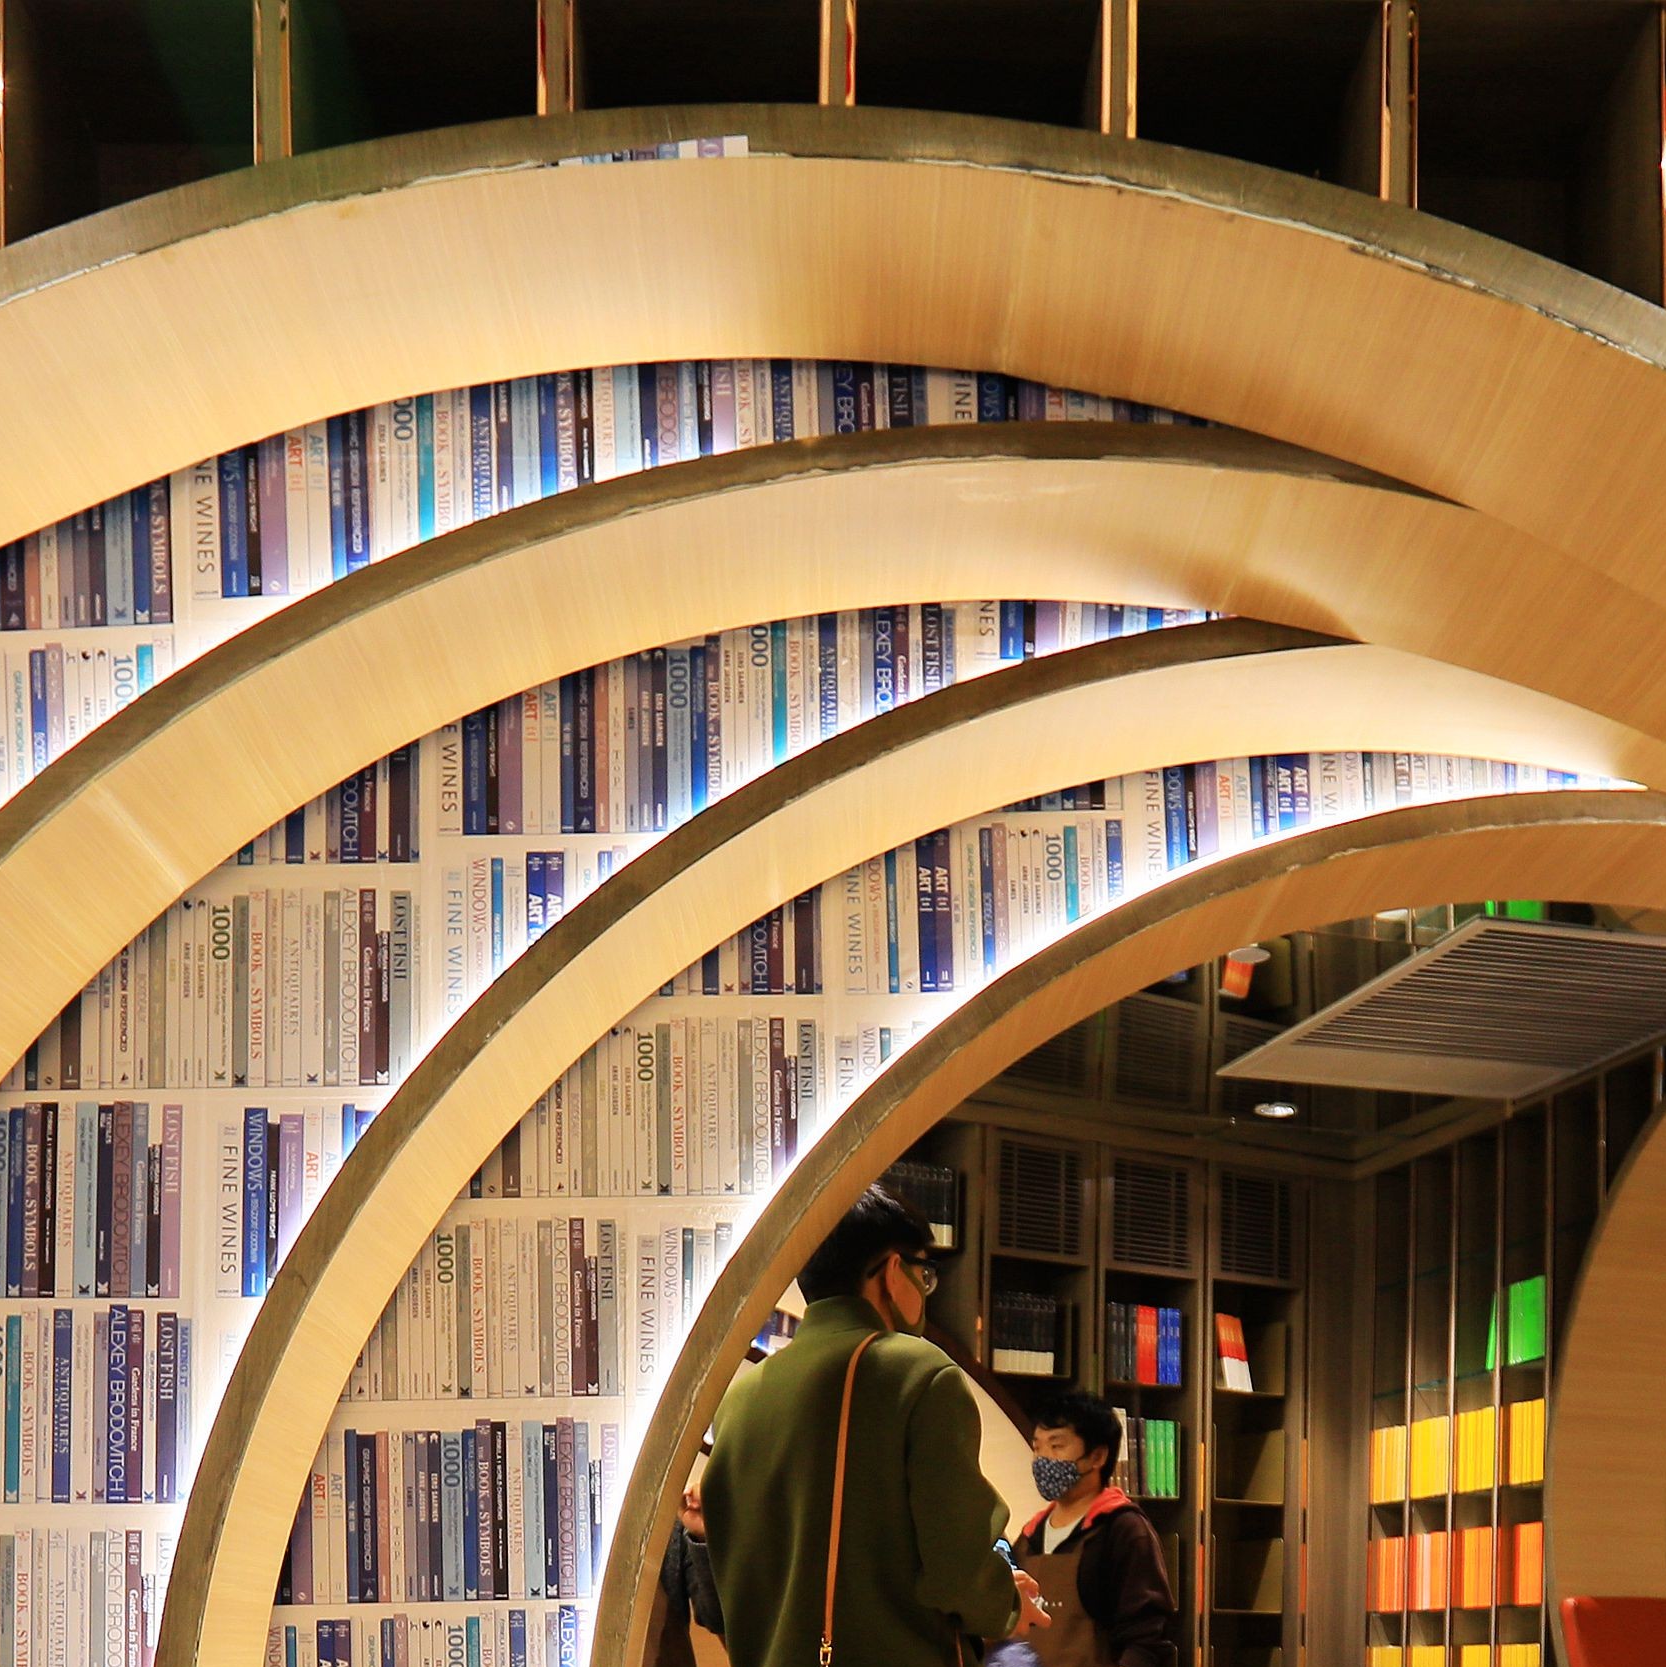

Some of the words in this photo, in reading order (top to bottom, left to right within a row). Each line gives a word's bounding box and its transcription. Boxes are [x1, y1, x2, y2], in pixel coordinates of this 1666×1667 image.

[196, 496, 214, 573] WINES
[667, 656, 688, 709] 1000
[442, 743, 457, 812] WINES
[919, 867, 931, 893] ART
[1046, 834, 1062, 881] 1000
[212, 906, 230, 960] 1000
[342, 888, 357, 954] ALEXEY
[394, 895, 407, 938] LOST
[448, 889, 462, 936] FINE
[394, 943, 406, 980] FISH
[849, 913, 862, 974] WINES
[638, 1032, 653, 1081] 1000
[755, 1016, 768, 1076] ALEXEY
[166, 1109, 179, 1152] LOST
[248, 1112, 263, 1192] WINDOWS
[26, 1143, 38, 1185] BOOK
[165, 1162, 178, 1192] FISH
[223, 1146, 238, 1192] FINE
[24, 1200, 36, 1271] SYMBOLS
[221, 1203, 237, 1273] WINES
[436, 1234, 453, 1283] 1000
[555, 1217, 568, 1277] ALEXEY
[641, 1257, 655, 1299] FINE
[111, 1309, 125, 1375] ALEXEY
[161, 1315, 173, 1359] LOST
[641, 1308, 653, 1373] WINES
[160, 1362, 173, 1400] FISH
[109, 1529, 124, 1593] ALEXEY
[17, 1572, 28, 1613] BOOK
